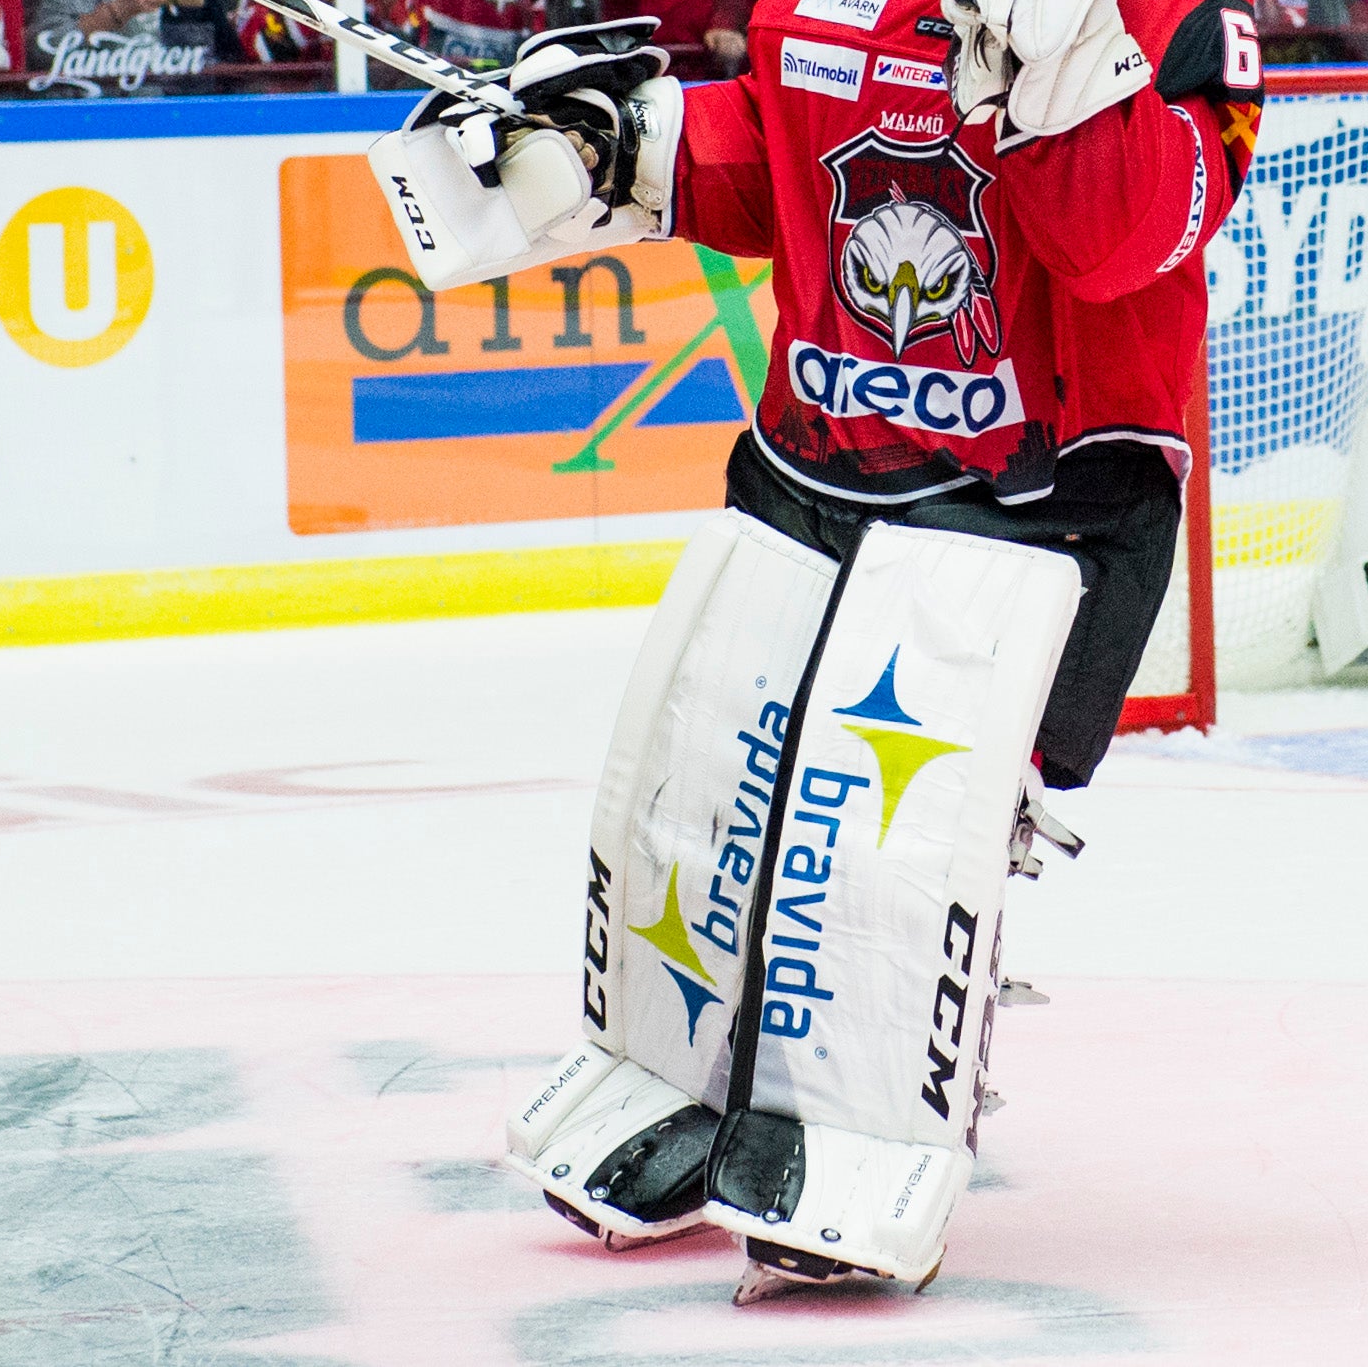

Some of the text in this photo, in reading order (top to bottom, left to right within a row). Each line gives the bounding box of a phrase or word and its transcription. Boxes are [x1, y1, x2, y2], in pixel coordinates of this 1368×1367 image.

[29, 29, 206, 98] Landgren
[338, 15, 490, 91] CCM
[916, 20, 952, 35] CC
[1114, 52, 1148, 77] CM
[1221, 8, 1262, 89] 6
[797, 58, 858, 86] Tillmobil
[879, 110, 945, 134] MALMÖ
[391, 175, 436, 252] CCM
[794, 347, 1007, 432] areco
[690, 699, 792, 957] bravida
[582, 846, 612, 1032] CCM
[760, 766, 872, 1040] bravida
[920, 901, 979, 1122] CCM
[522, 1054, 590, 1124] PREMIER
[891, 1152, 932, 1220] PREMIER
